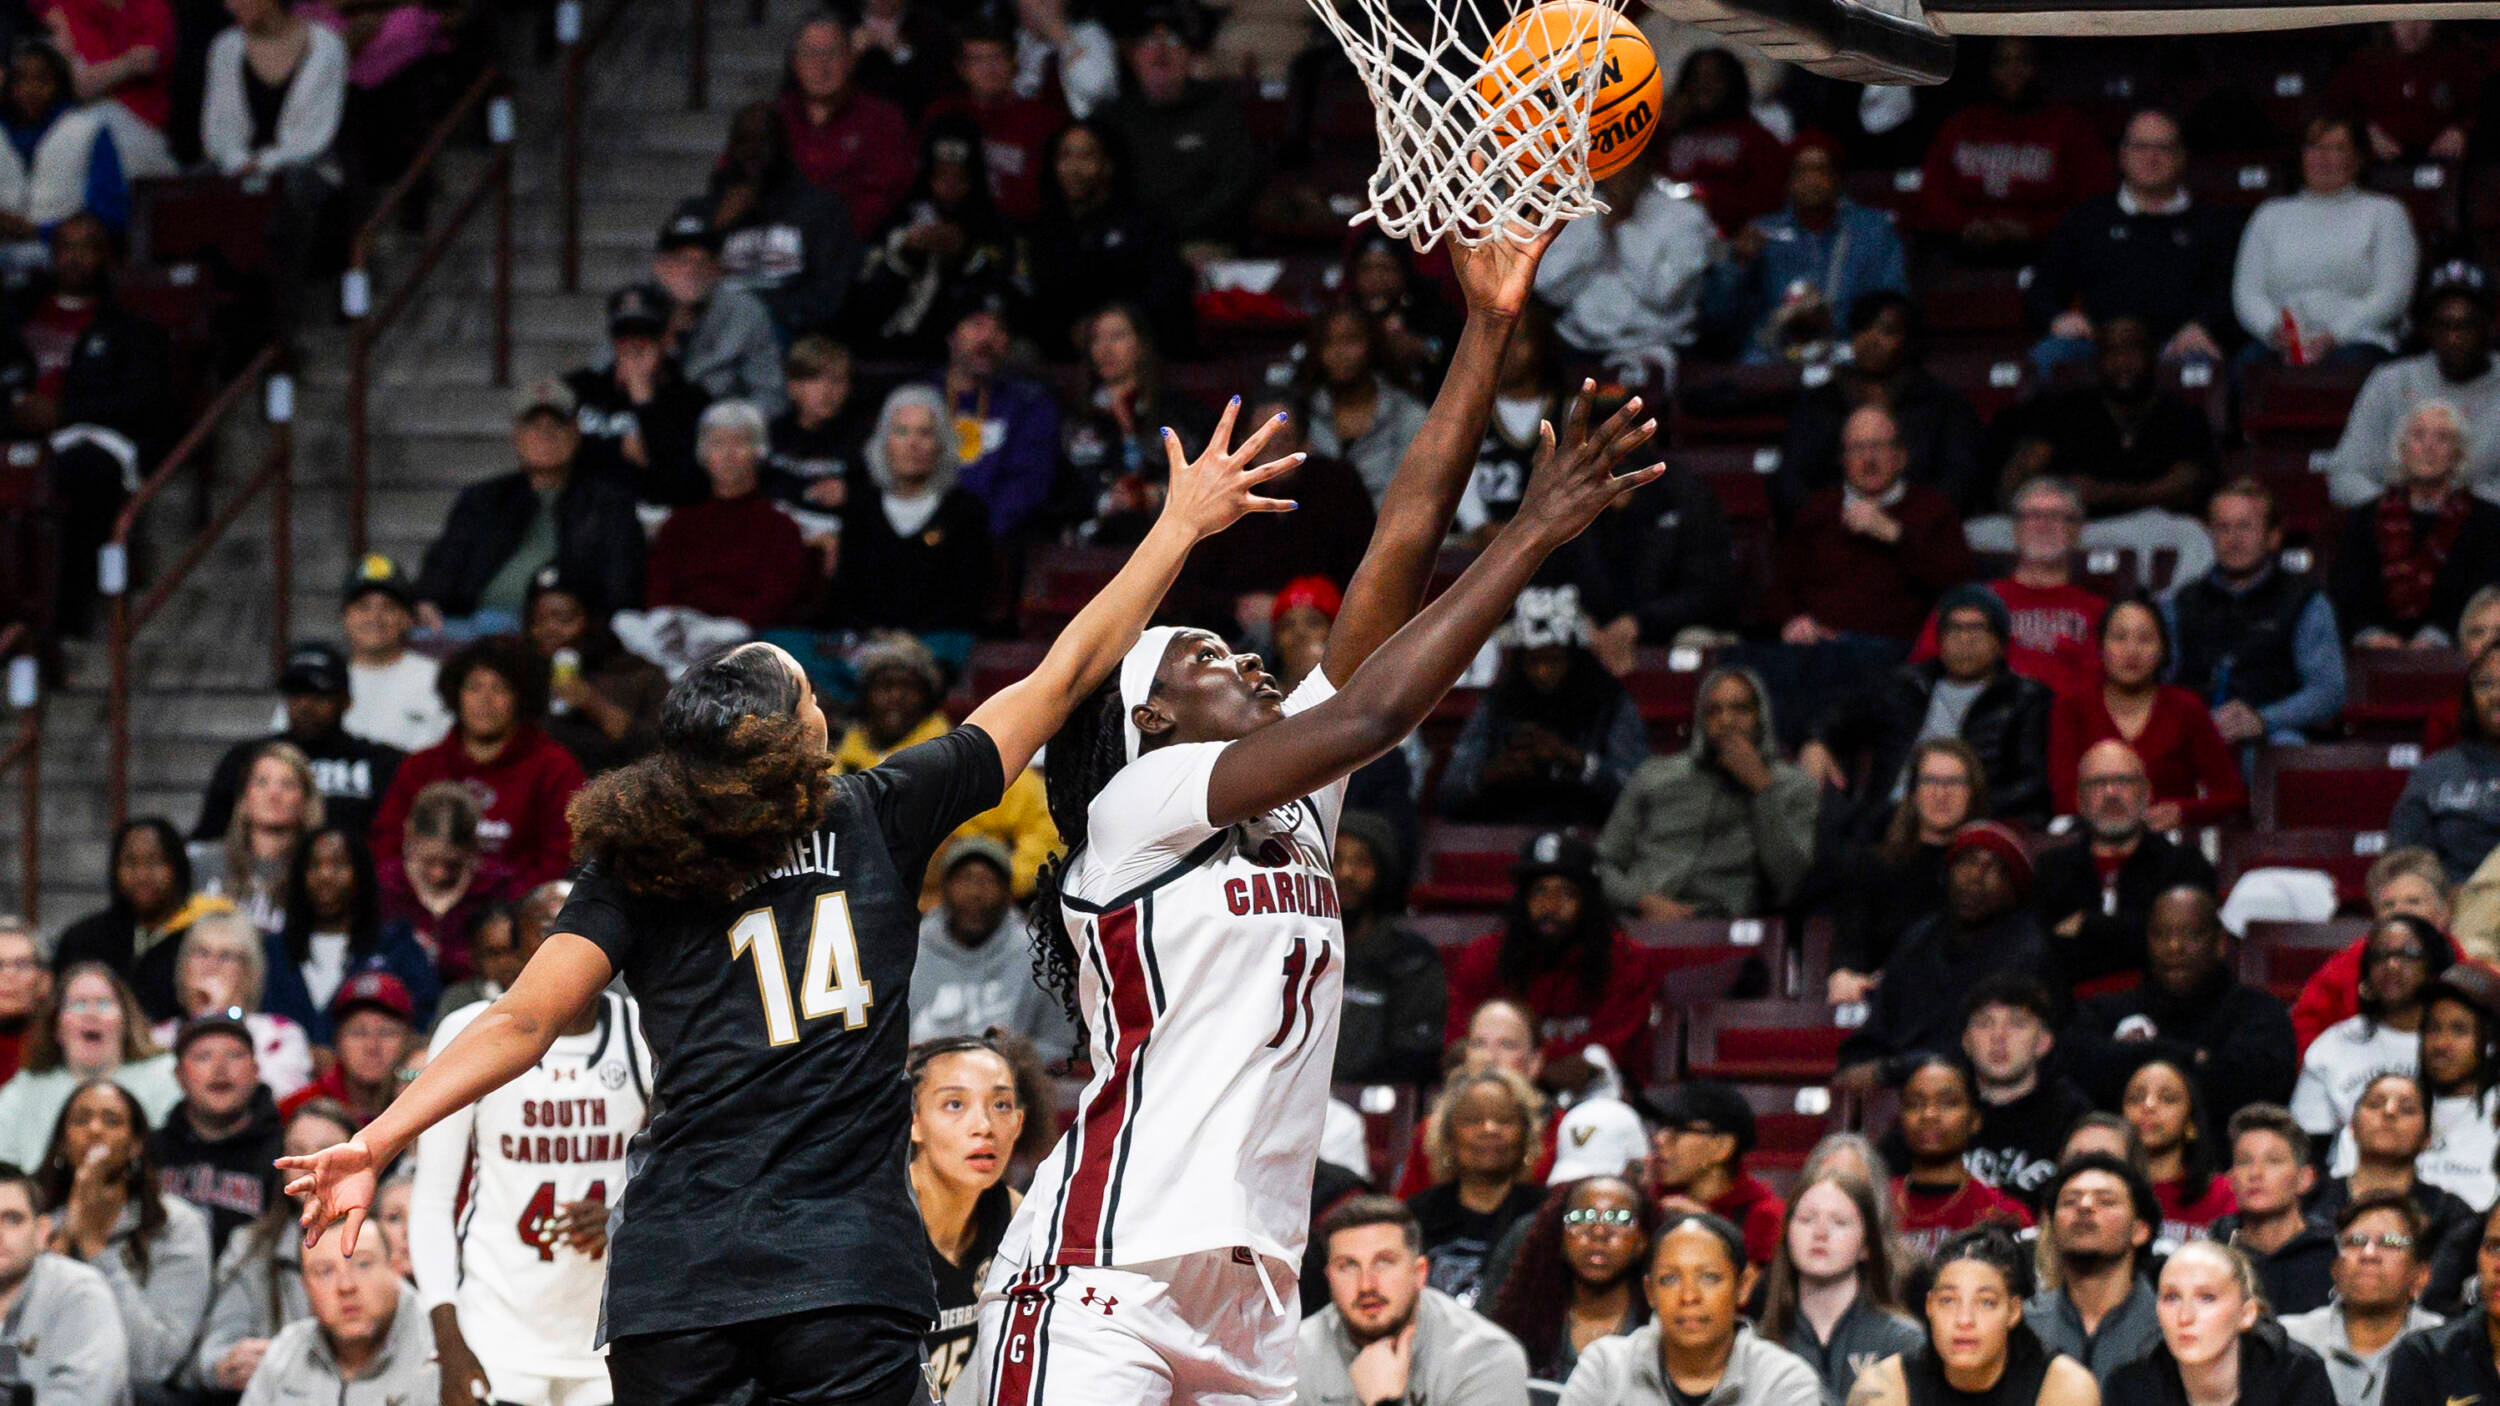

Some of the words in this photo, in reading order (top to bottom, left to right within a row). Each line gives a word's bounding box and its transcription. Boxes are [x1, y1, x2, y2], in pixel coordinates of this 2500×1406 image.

[1223, 871, 1341, 919] CAROLIN
[727, 890, 874, 1047] 14
[1265, 937, 1331, 1049] 11
[522, 1099, 606, 1128] SOUTH
